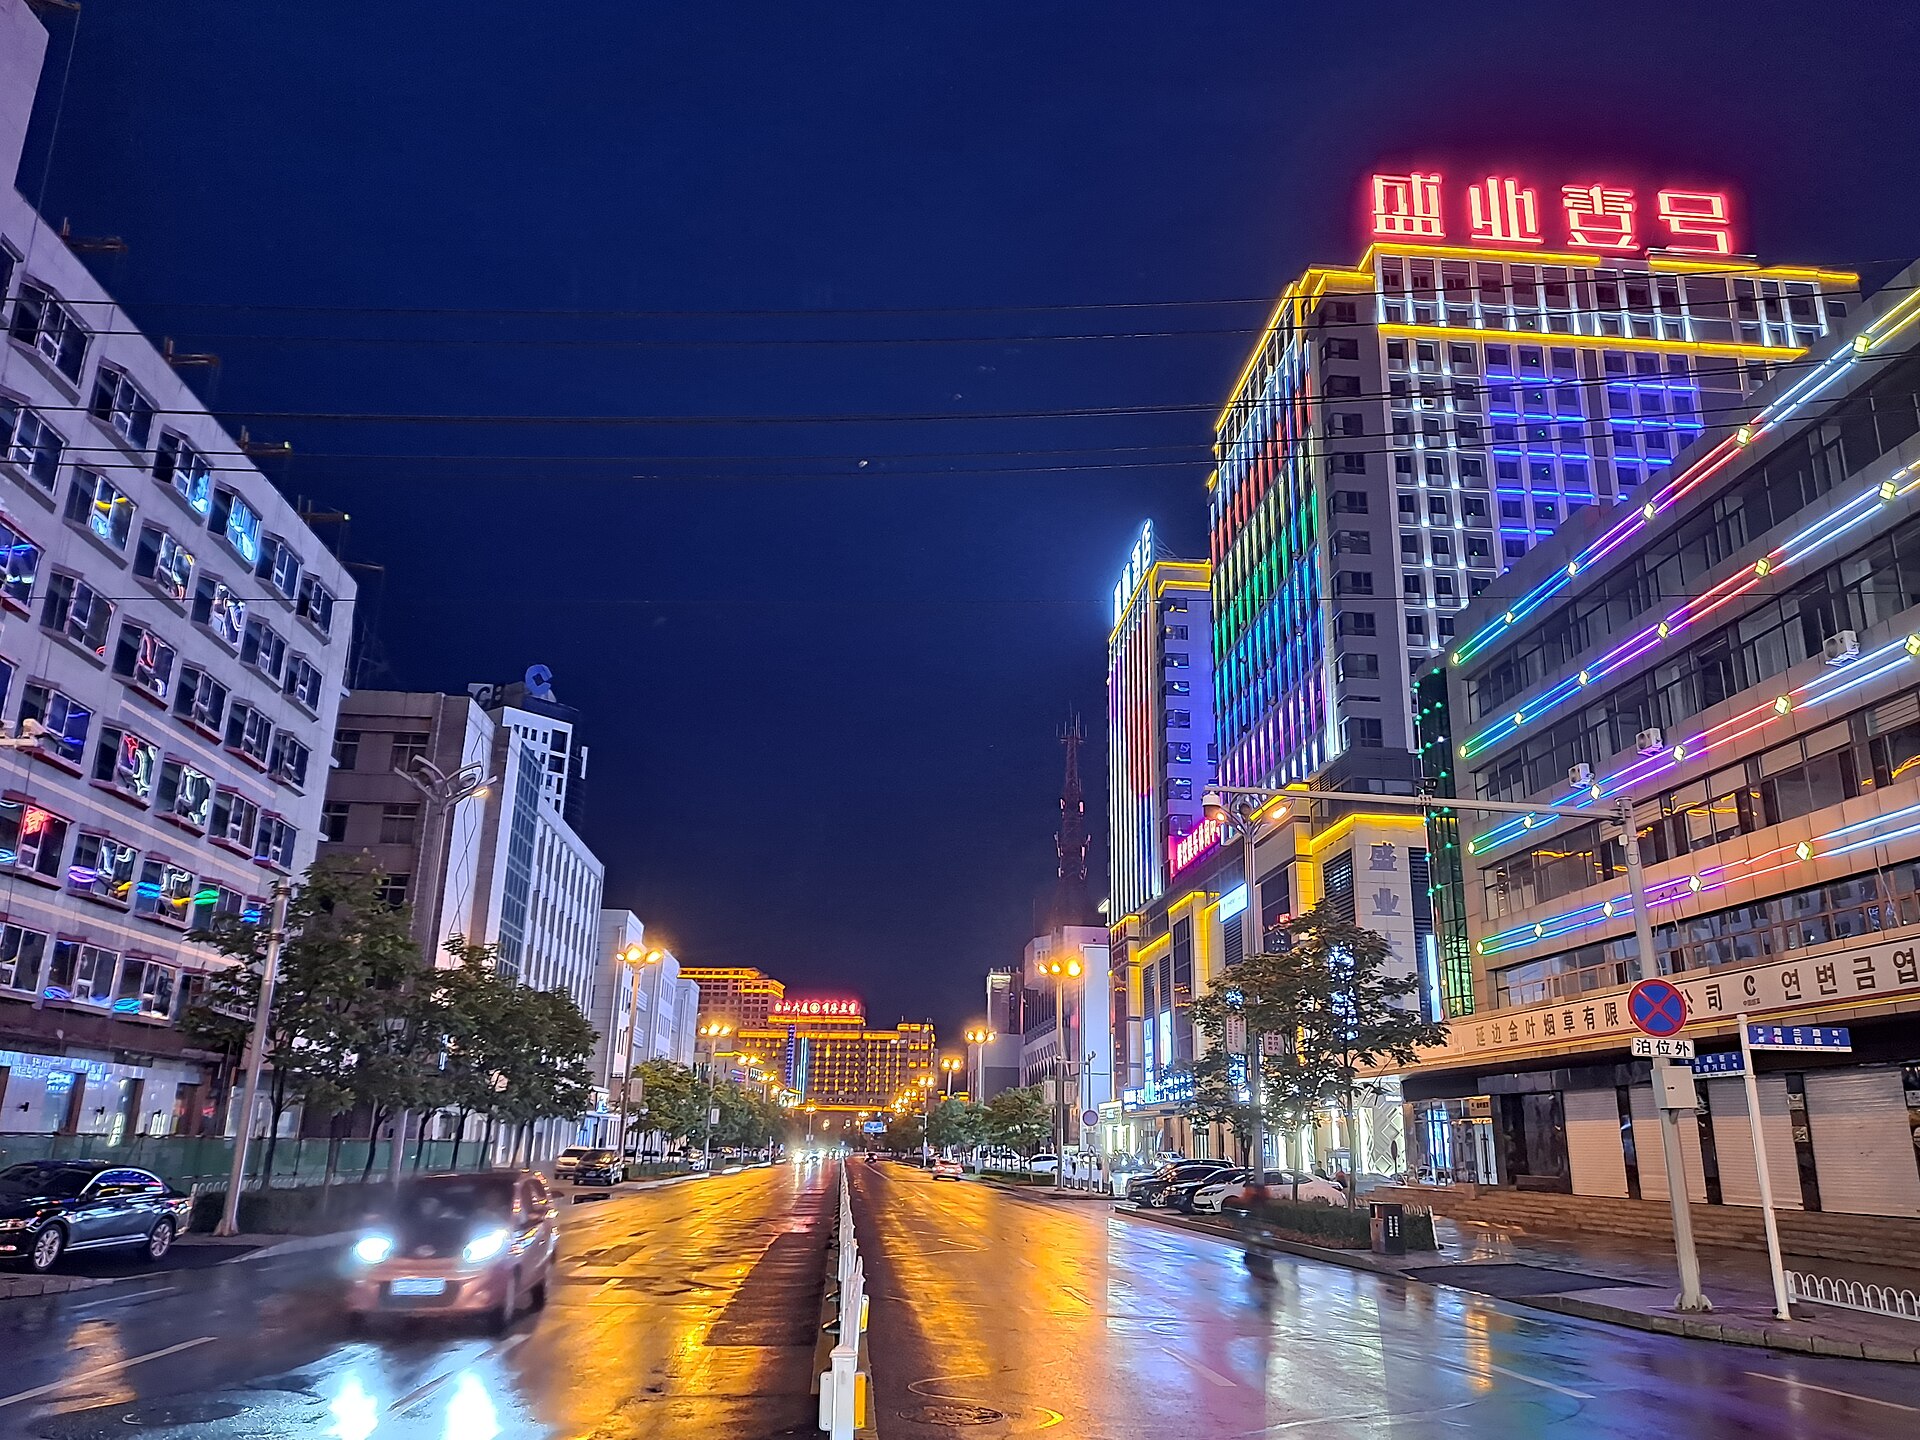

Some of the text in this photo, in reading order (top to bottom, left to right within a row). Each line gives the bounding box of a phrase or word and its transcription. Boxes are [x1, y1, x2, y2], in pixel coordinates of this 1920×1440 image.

[1372, 173, 1730, 254] 盛业壹号
[1781, 947, 1919, 1001] 연변금엽
[1475, 983, 1723, 1047] 延边金叶烟草有限公司
[1635, 1039, 1691, 1058] 泊位外
